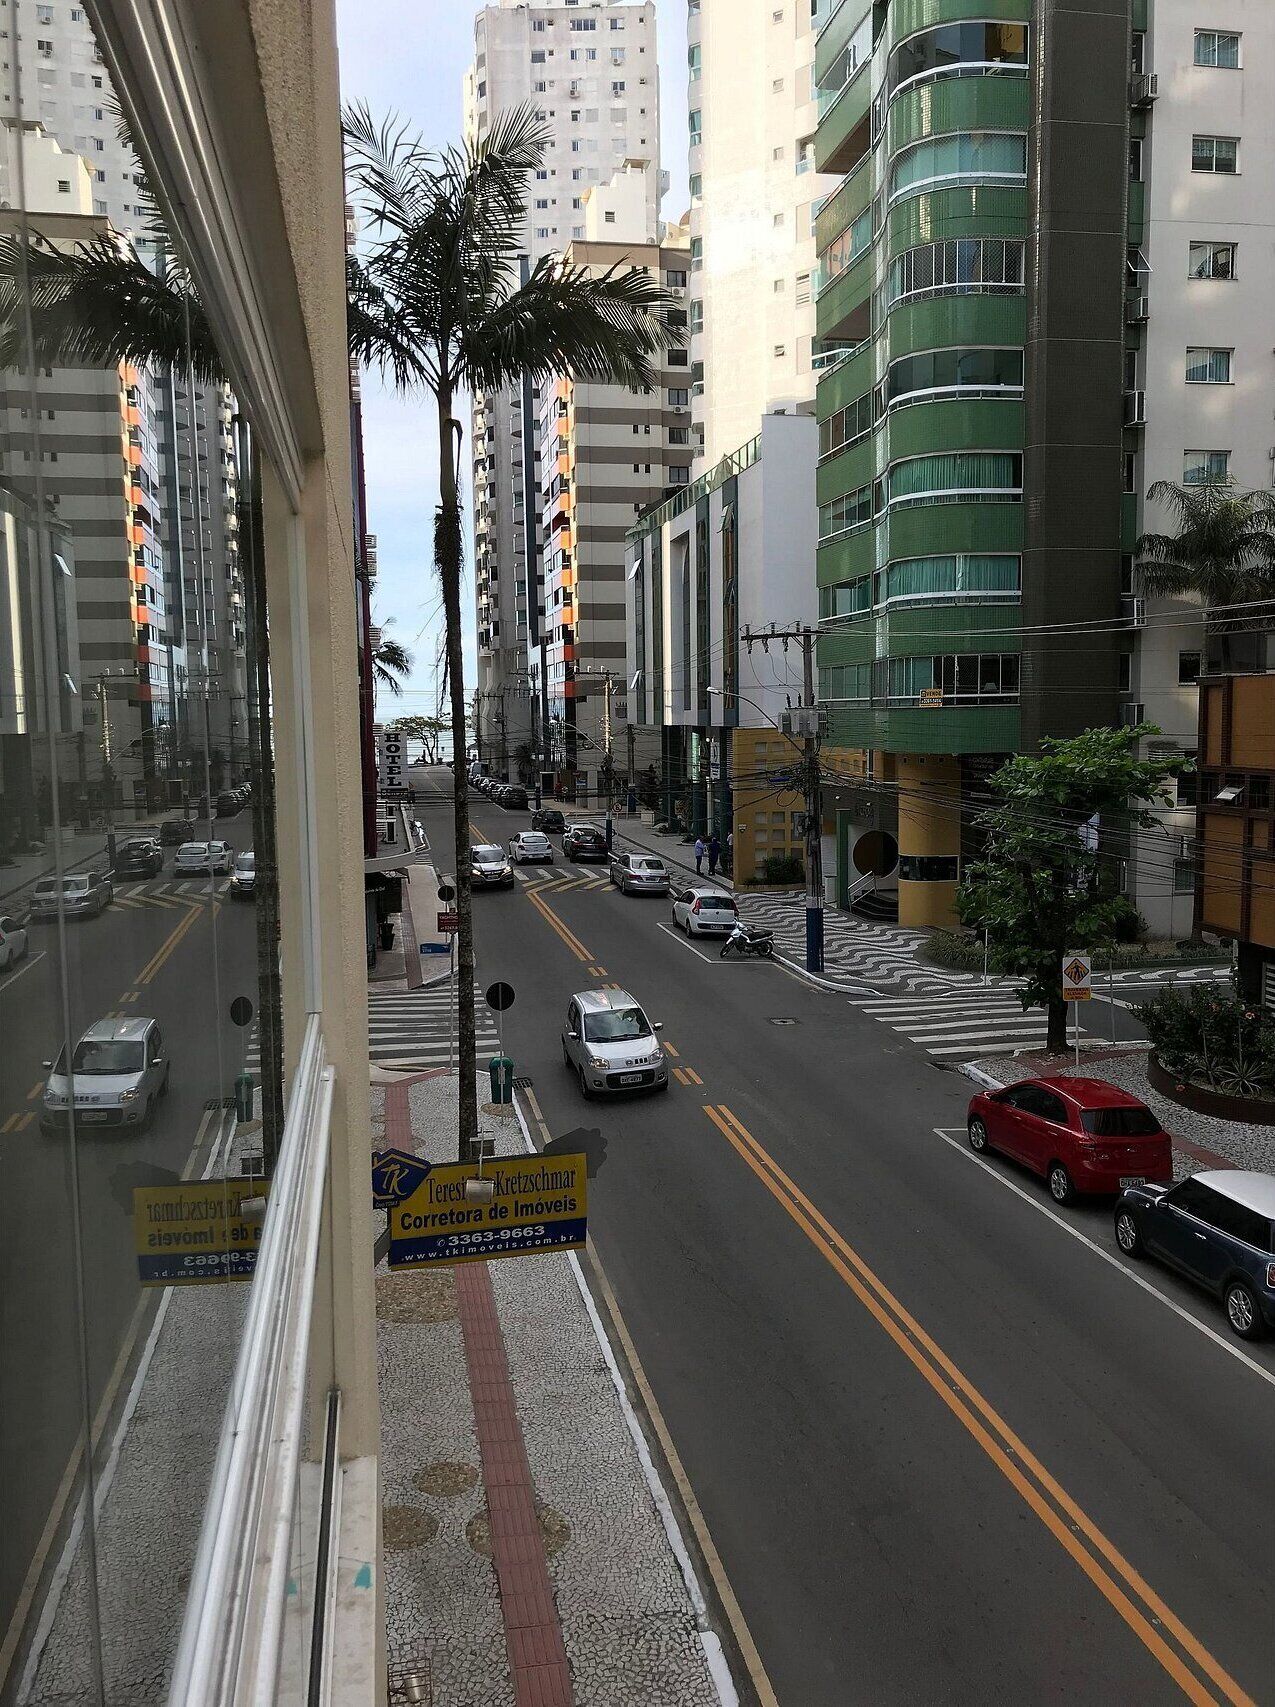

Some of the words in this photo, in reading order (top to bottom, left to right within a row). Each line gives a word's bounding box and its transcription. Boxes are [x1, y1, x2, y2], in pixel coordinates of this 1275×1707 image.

[384, 733, 402, 787] HOTEL
[427, 1174, 497, 1204] Teresi
[496, 1165, 576, 1197] Kretzschmar
[400, 1207, 483, 1231] Corretora
[488, 1202, 509, 1220] de
[514, 1194, 577, 1219] Imóveis
[448, 1225, 545, 1247] 3363-9663
